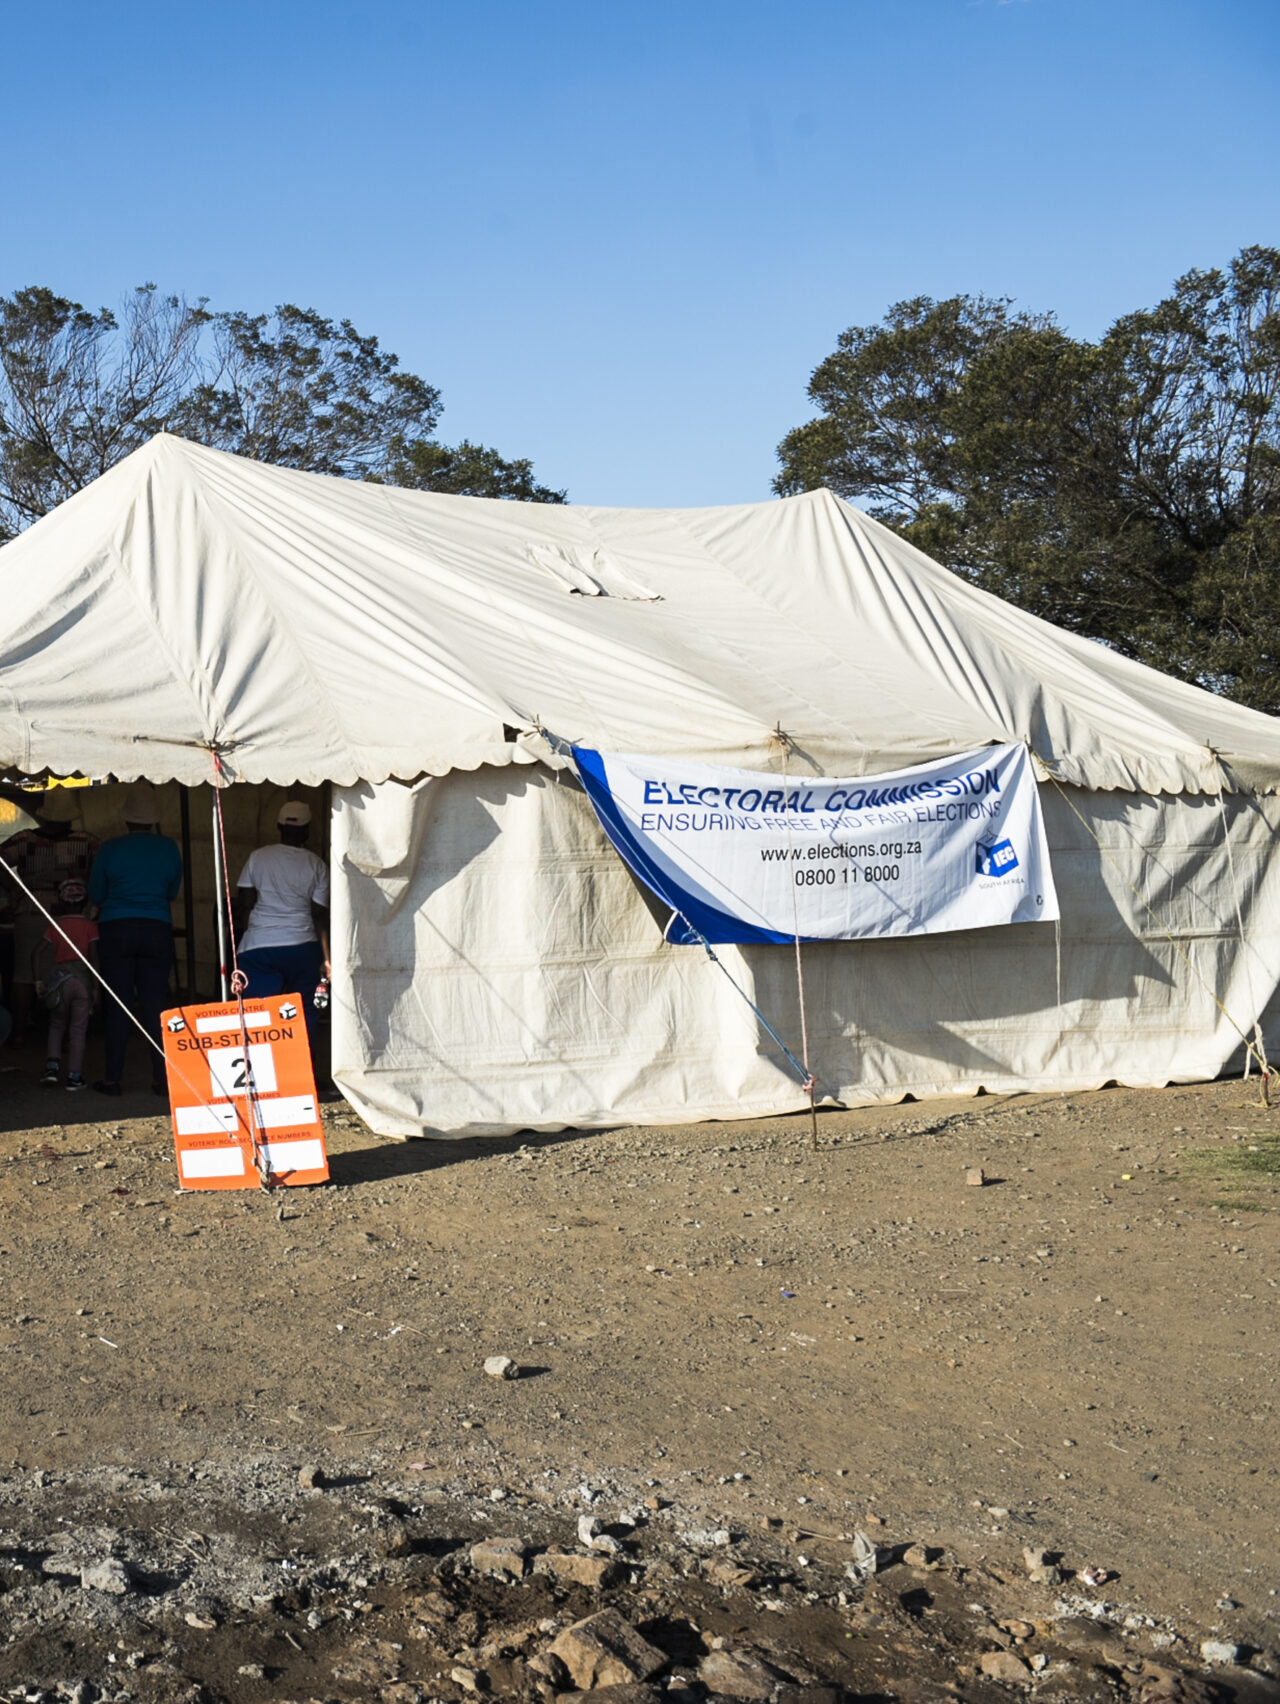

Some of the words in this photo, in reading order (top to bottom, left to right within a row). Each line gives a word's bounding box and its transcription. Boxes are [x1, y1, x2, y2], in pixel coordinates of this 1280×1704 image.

[644, 780, 816, 813] ELECTORAL
[824, 768, 1001, 812] COMMISSION
[641, 813, 762, 831] ENSURING
[762, 817, 818, 831] FREE
[820, 815, 862, 831] AND
[865, 810, 912, 826] FAIR
[913, 800, 1002, 823] ELECTIONS
[761, 841, 922, 861] www.elections.org.za
[992, 845, 1015, 868] IEC
[795, 868, 836, 886] 0800
[841, 867, 858, 884] 11
[864, 864, 900, 882] 8000
[195, 1008, 229, 1018] VOTING
[177, 1027, 294, 1051] SUB-STATION
[231, 1058, 255, 1089] 2
[277, 1131, 311, 1140] NUMBERS
